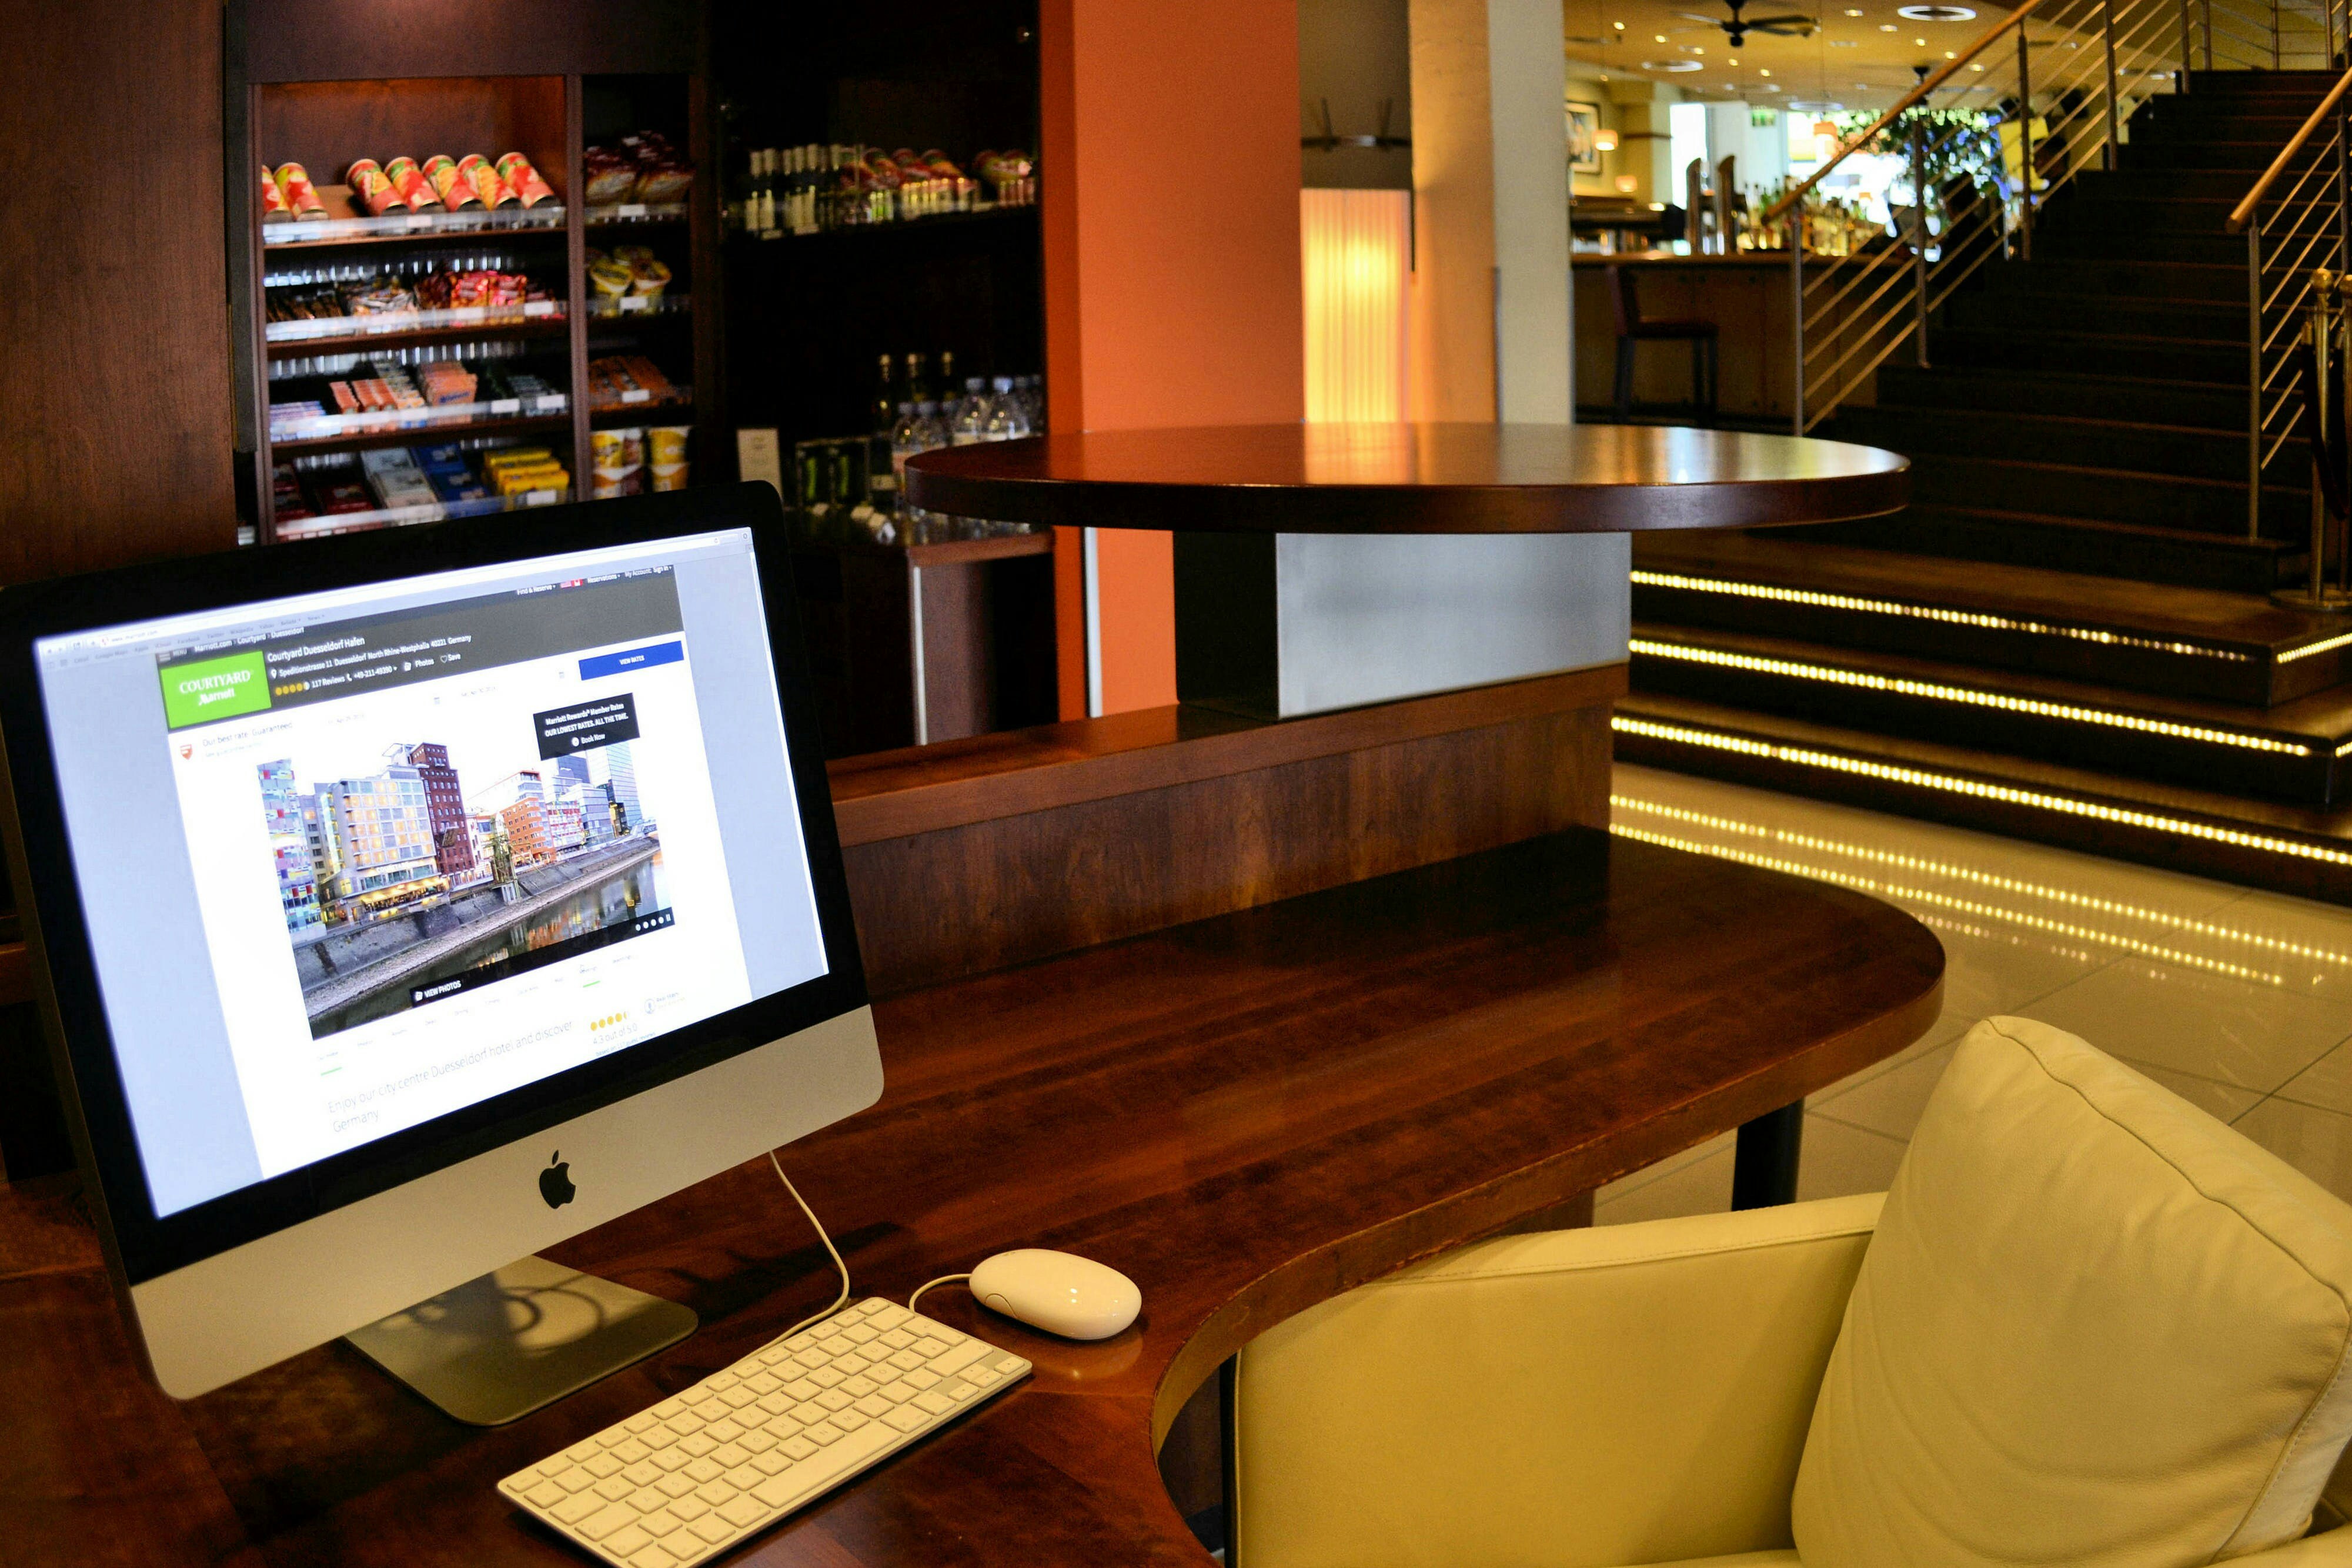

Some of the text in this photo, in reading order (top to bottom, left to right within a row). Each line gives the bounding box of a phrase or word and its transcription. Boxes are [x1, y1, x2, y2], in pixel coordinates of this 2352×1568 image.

[194, 627, 305, 652] Marriott.com Courtyard Duesseldorf
[268, 637, 365, 662] Courtyard Duesseldorf Hafen
[279, 662, 325, 677] Speditionstrasse
[335, 653, 366, 666] Duesseldorf
[368, 651, 384, 660] North
[384, 642, 430, 657] Rhine-Westphalia
[431, 638, 446, 647] 40221
[447, 635, 472, 644] Germany
[415, 658, 435, 667] Photos
[447, 653, 461, 661] Save
[179, 670, 251, 694] COURTYARD
[323, 676, 345, 686] Reviews
[199, 688, 235, 706] Marriott
[545, 715, 566, 725] Marriott
[610, 703, 624, 711] Rates
[544, 728, 557, 737] OUR
[558, 724, 577, 735] LOWEST
[605, 716, 615, 724] THE
[581, 736, 594, 744] Book
[424, 980, 462, 998] VIEW PHOTOS
[328, 1097, 356, 1114] Enjoy
[359, 1091, 375, 1103] our
[399, 1071, 429, 1089] centre
[430, 1047, 487, 1078] Duesseldorf
[489, 1039, 514, 1057] hotel
[516, 1032, 534, 1048] and
[535, 1020, 573, 1042] discover
[333, 1109, 379, 1132] Germany
